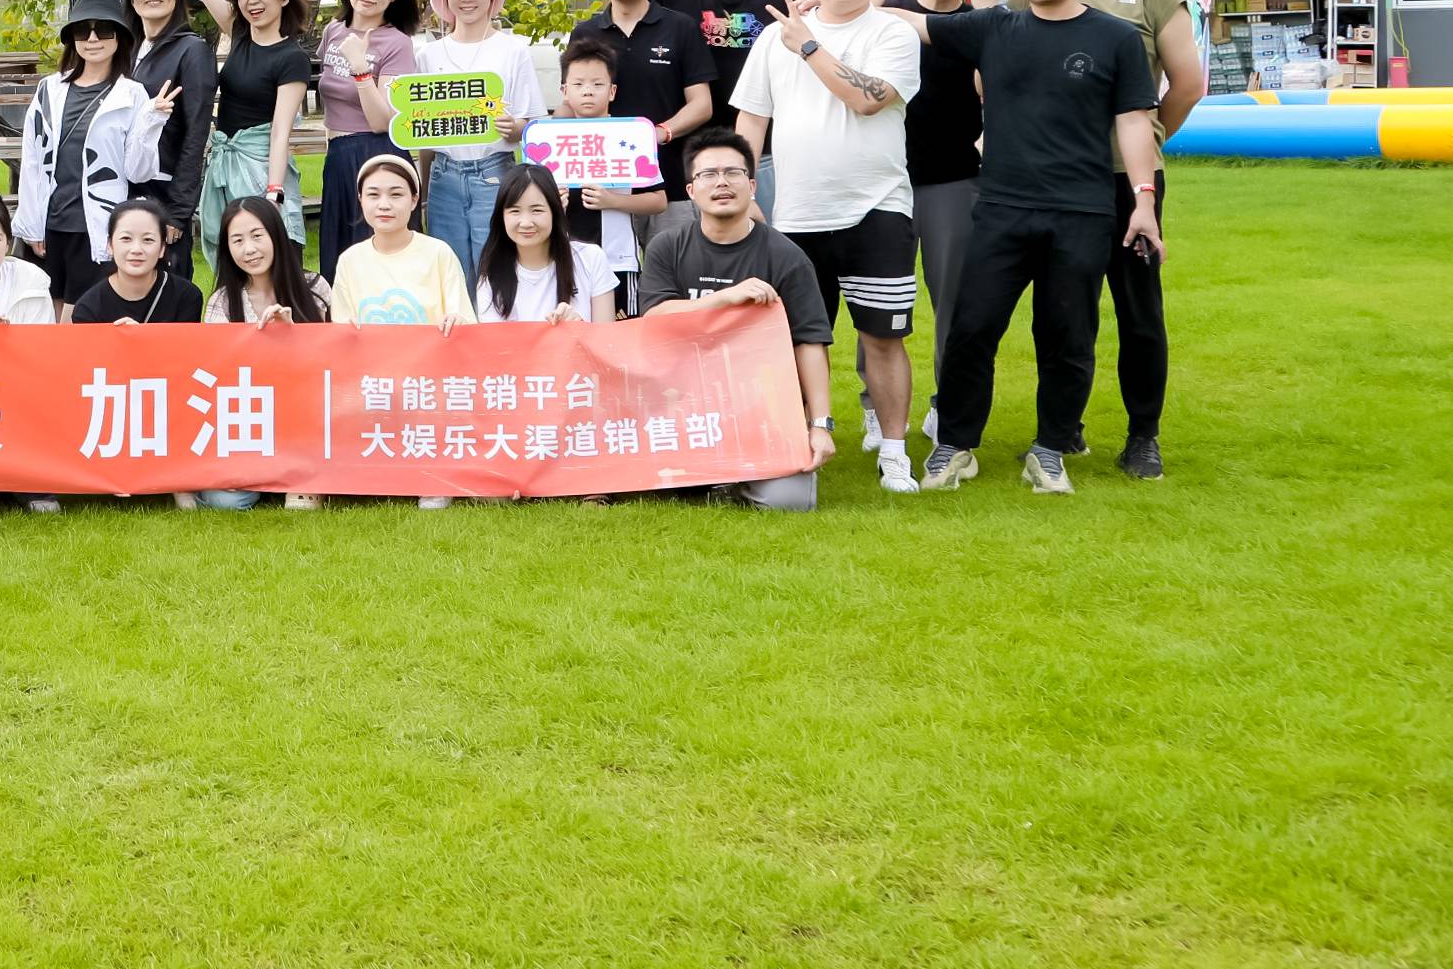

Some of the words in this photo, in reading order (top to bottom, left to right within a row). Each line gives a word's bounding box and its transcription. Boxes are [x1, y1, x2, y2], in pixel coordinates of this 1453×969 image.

[410, 78, 486, 102] 生活苟且
[412, 115, 489, 138] 放肆撒野
[556, 134, 605, 157] 无敌
[565, 159, 632, 179] 内卷王
[360, 374, 597, 412] 智能营销平台
[80, 367, 275, 459] 加油
[360, 412, 723, 462] 大娱乐大渠道销售部
